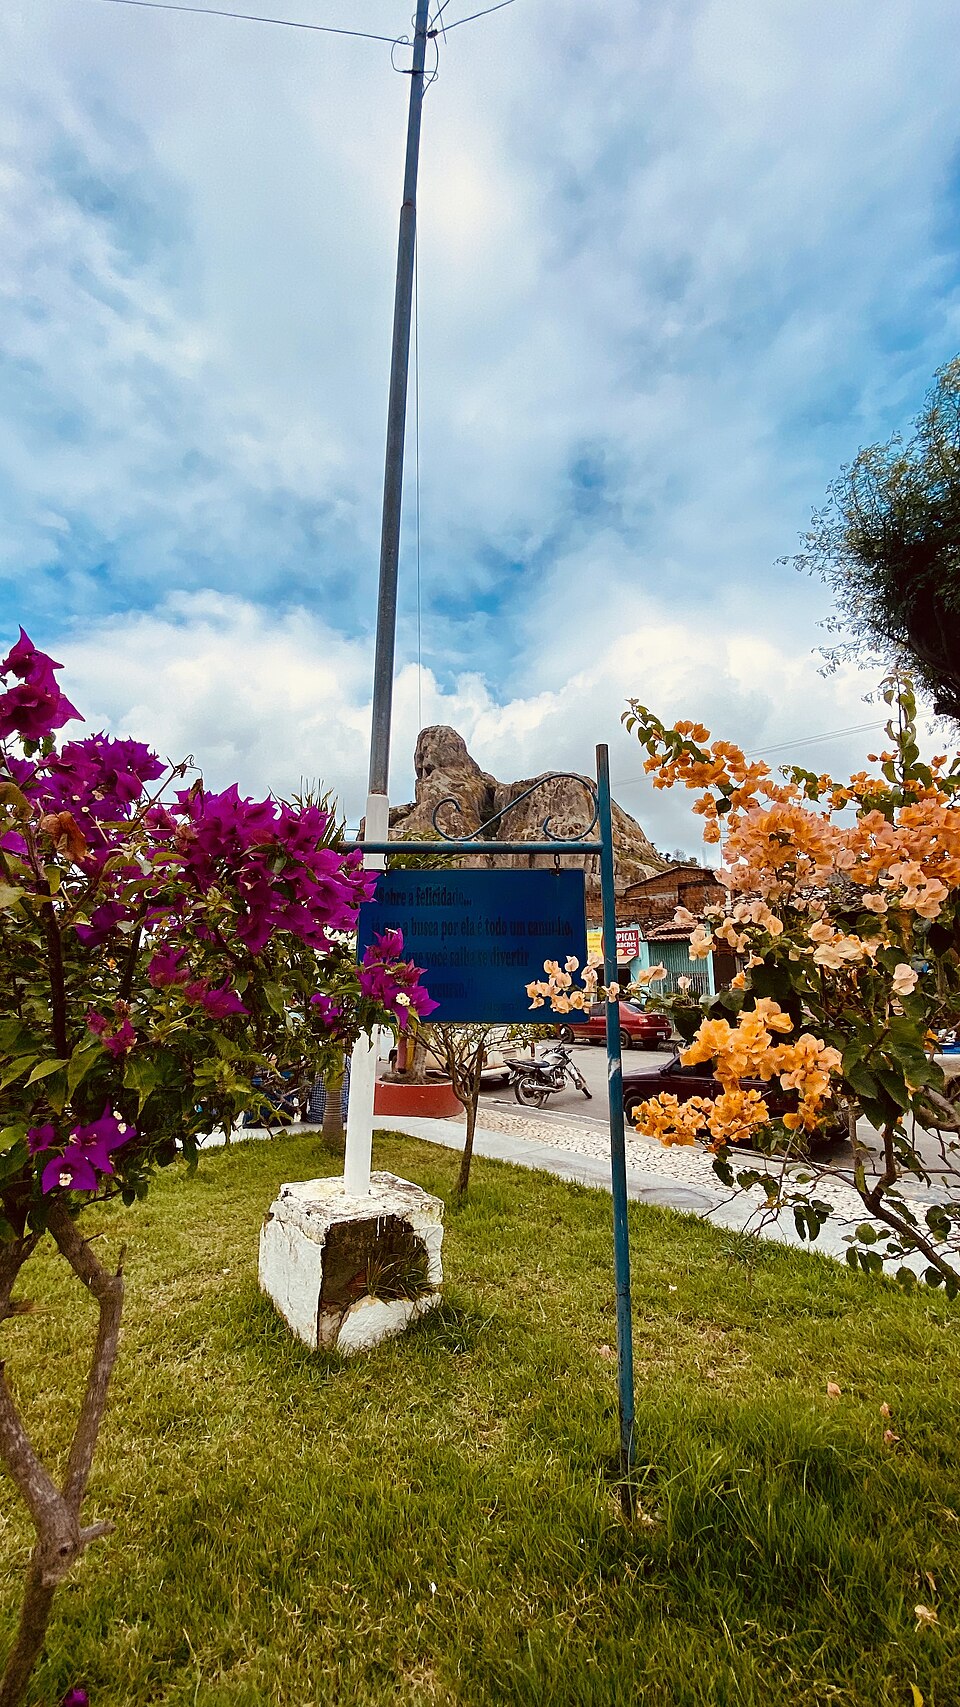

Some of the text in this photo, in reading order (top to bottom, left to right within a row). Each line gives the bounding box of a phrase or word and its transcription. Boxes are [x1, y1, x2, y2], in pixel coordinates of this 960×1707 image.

[407, 890, 414, 906] a
[402, 920, 409, 937] a
[410, 915, 439, 937] busca
[440, 919, 459, 942] por
[460, 915, 475, 937] ela
[476, 914, 483, 937] é
[484, 915, 508, 937] todo
[509, 919, 526, 937] um
[527, 915, 574, 943] caminho,
[615, 932, 637, 942] PICAL
[425, 945, 448, 967] você
[449, 945, 475, 967] saiba
[477, 950, 488, 967] se
[489, 944, 530, 967] divertir
